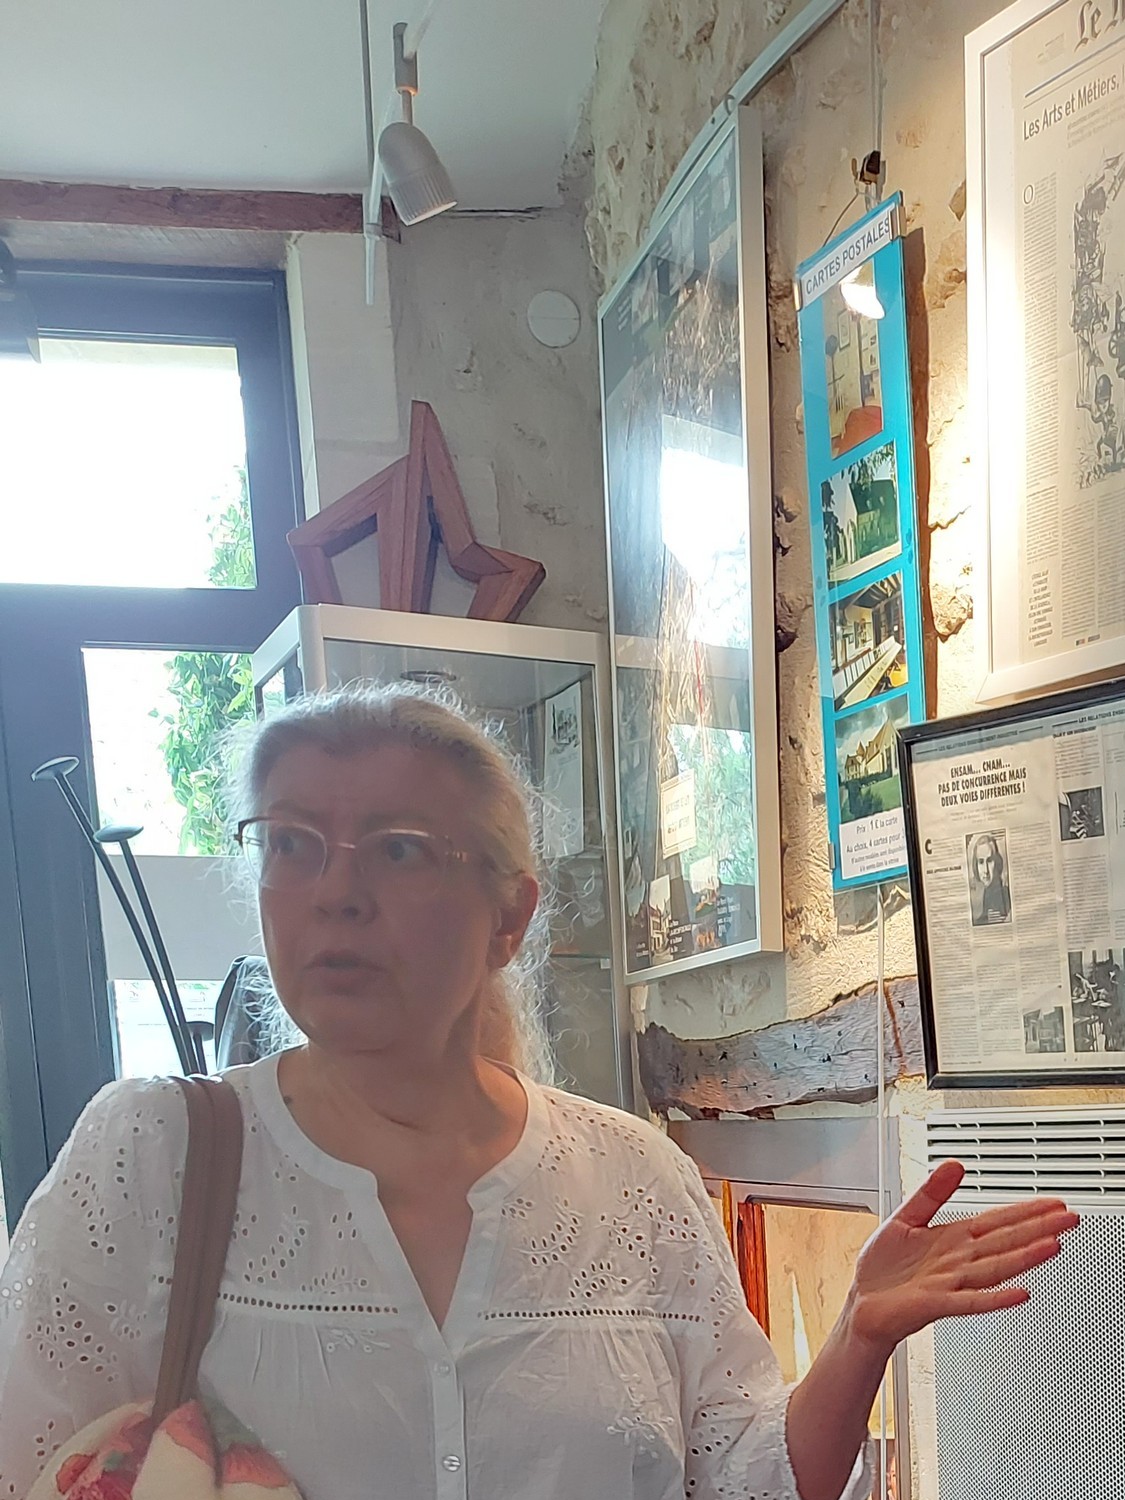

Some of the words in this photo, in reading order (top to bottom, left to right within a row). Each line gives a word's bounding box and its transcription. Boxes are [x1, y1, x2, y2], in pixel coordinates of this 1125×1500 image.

[1074, 0, 1101, 52] Le
[1023, 118, 1040, 141] Les
[1042, 103, 1063, 130] Arts
[1064, 93, 1076, 116] et
[1077, 74, 1120, 110] Métiers,
[805, 256, 840, 295] CARTES
[842, 217, 890, 267] POSTALES
[938, 783, 950, 795] PAS
[951, 781, 960, 792] DE
[961, 772, 1007, 790] CONCURRENCE
[1008, 767, 1027, 780] MAIS
[941, 795, 958, 807] DEUX
[960, 789, 979, 804] VOIES
